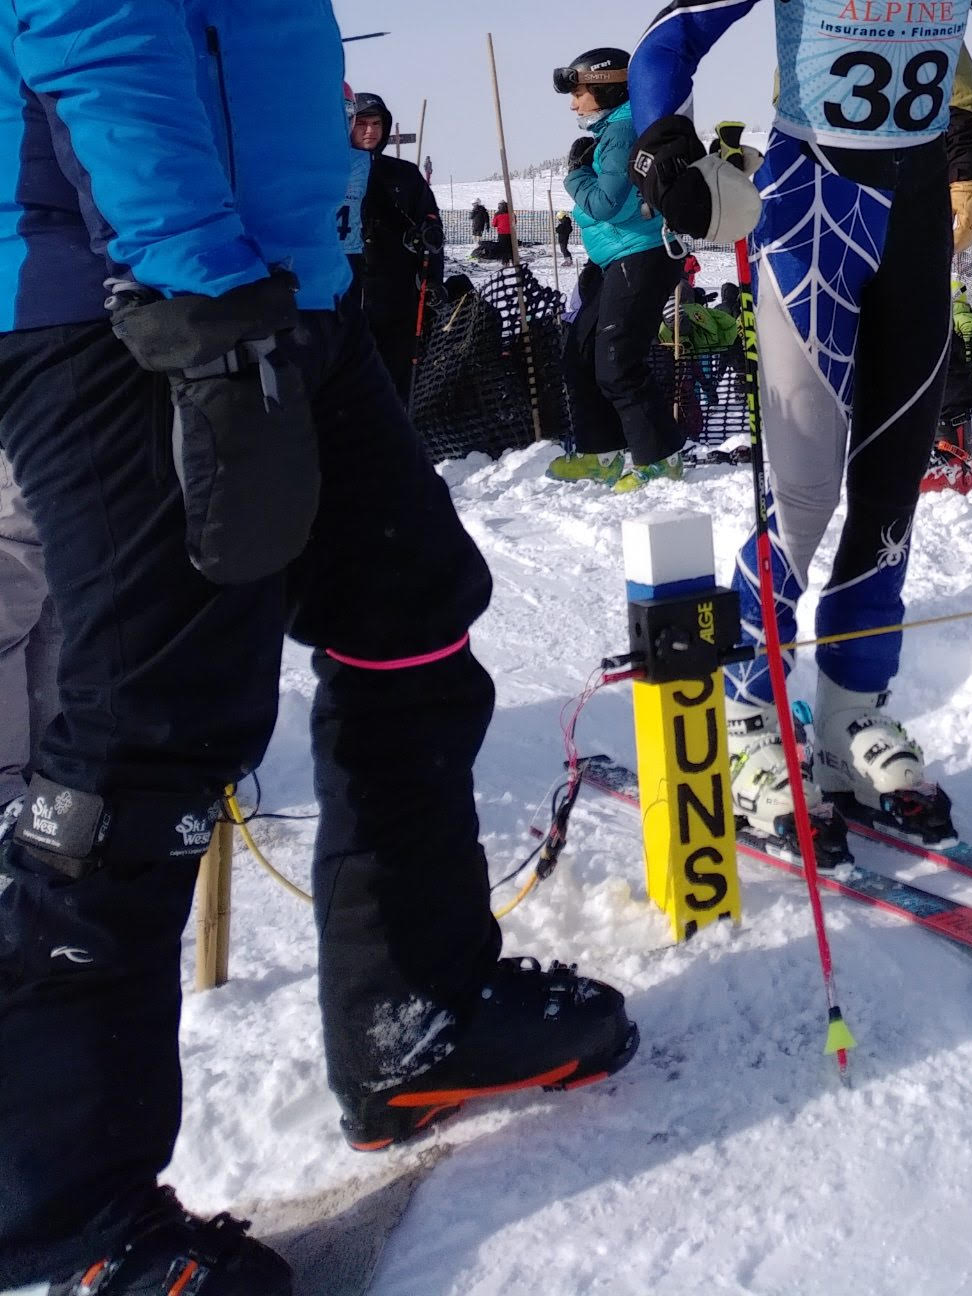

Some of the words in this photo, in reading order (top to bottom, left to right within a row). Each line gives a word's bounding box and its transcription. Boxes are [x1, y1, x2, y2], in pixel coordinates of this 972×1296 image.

[838, 0, 954, 23] ALPINE
[820, 20, 895, 37] Insurance
[823, 50, 949, 132] 38
[741, 292, 759, 362] LEKI
[697, 600, 715, 645] ALGE
[31, 796, 53, 820] Ski
[672, 676, 731, 942] UNS
[32, 813, 58, 836] West
[175, 814, 206, 833] Ski
